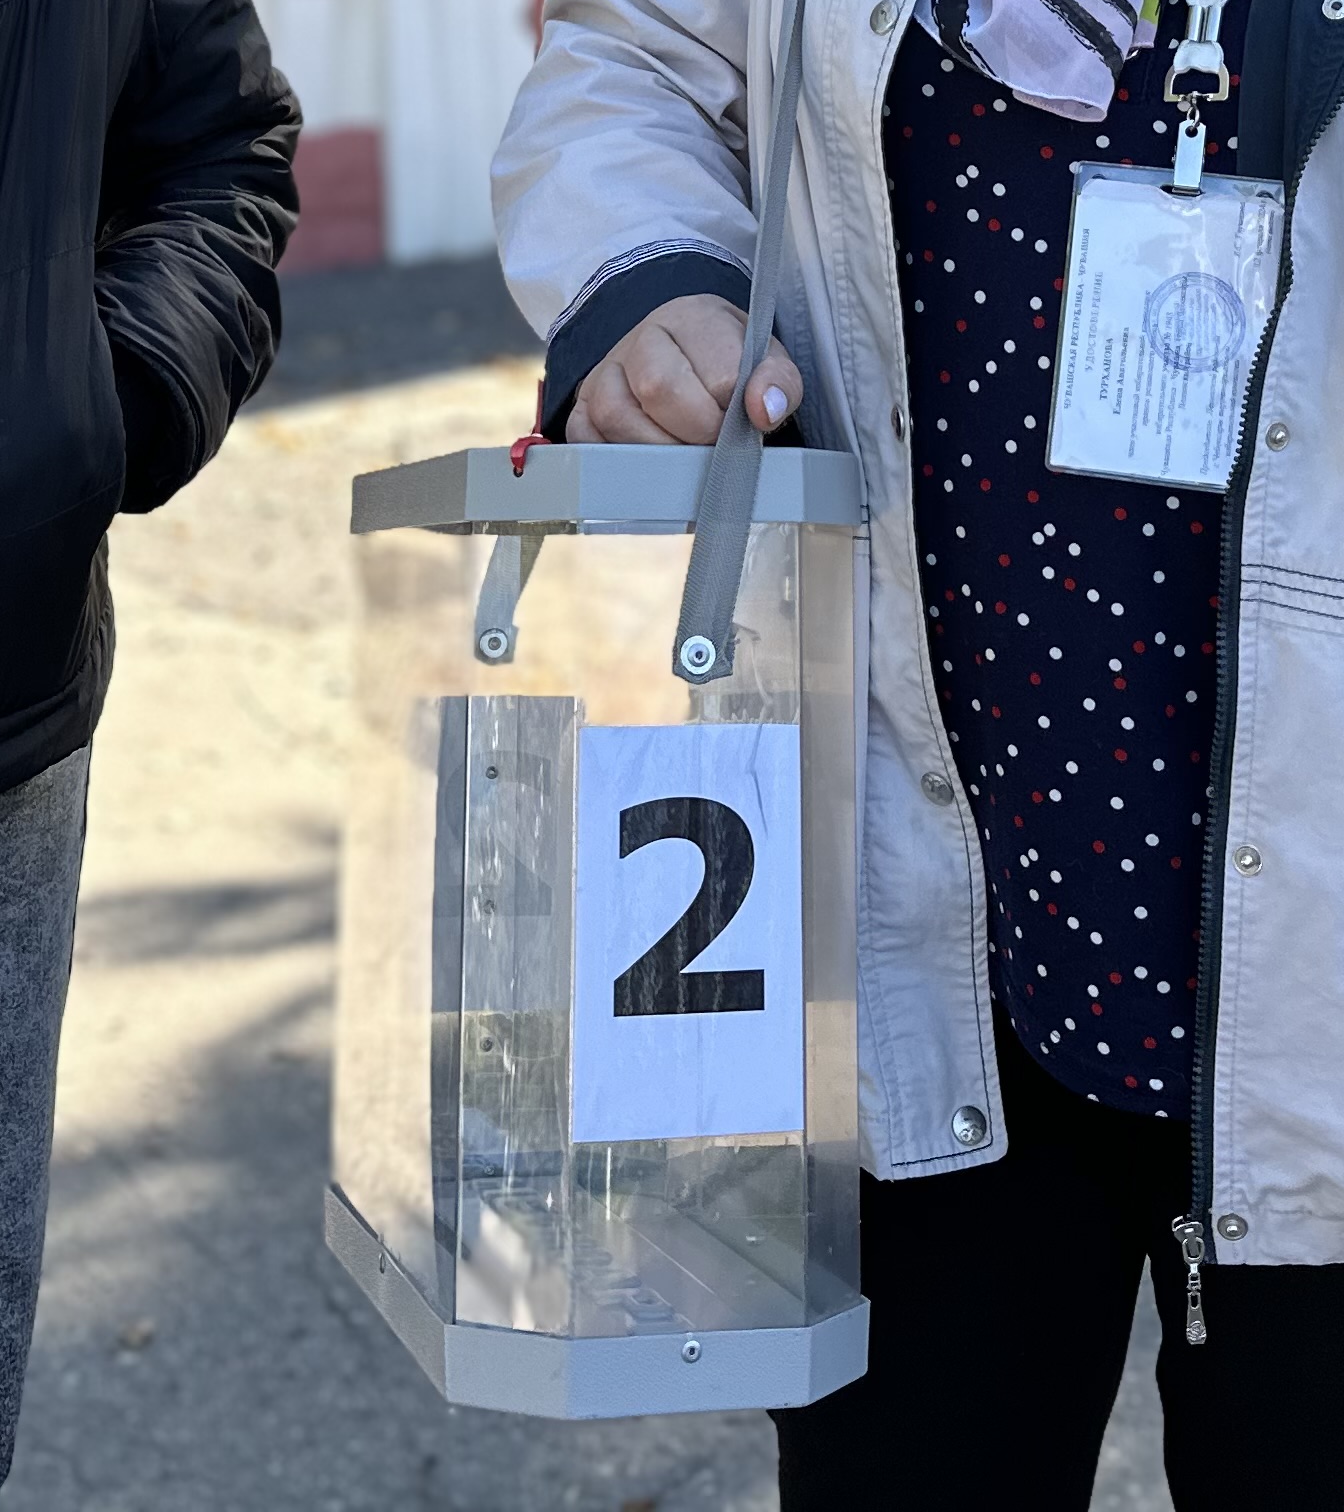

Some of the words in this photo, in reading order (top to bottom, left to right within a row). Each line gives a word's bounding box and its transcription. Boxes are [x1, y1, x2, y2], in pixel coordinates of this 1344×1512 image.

[1063, 348, 1077, 409] ЧУВАШСКАЯ
[1070, 283, 1084, 346] РЕСПУБЛИКА
[1084, 271, 1103, 372] УДОСТОВЕРЕНИЕ
[1099, 337, 1113, 400] ТУРХАНОВА
[613, 796, 765, 1017] 2
